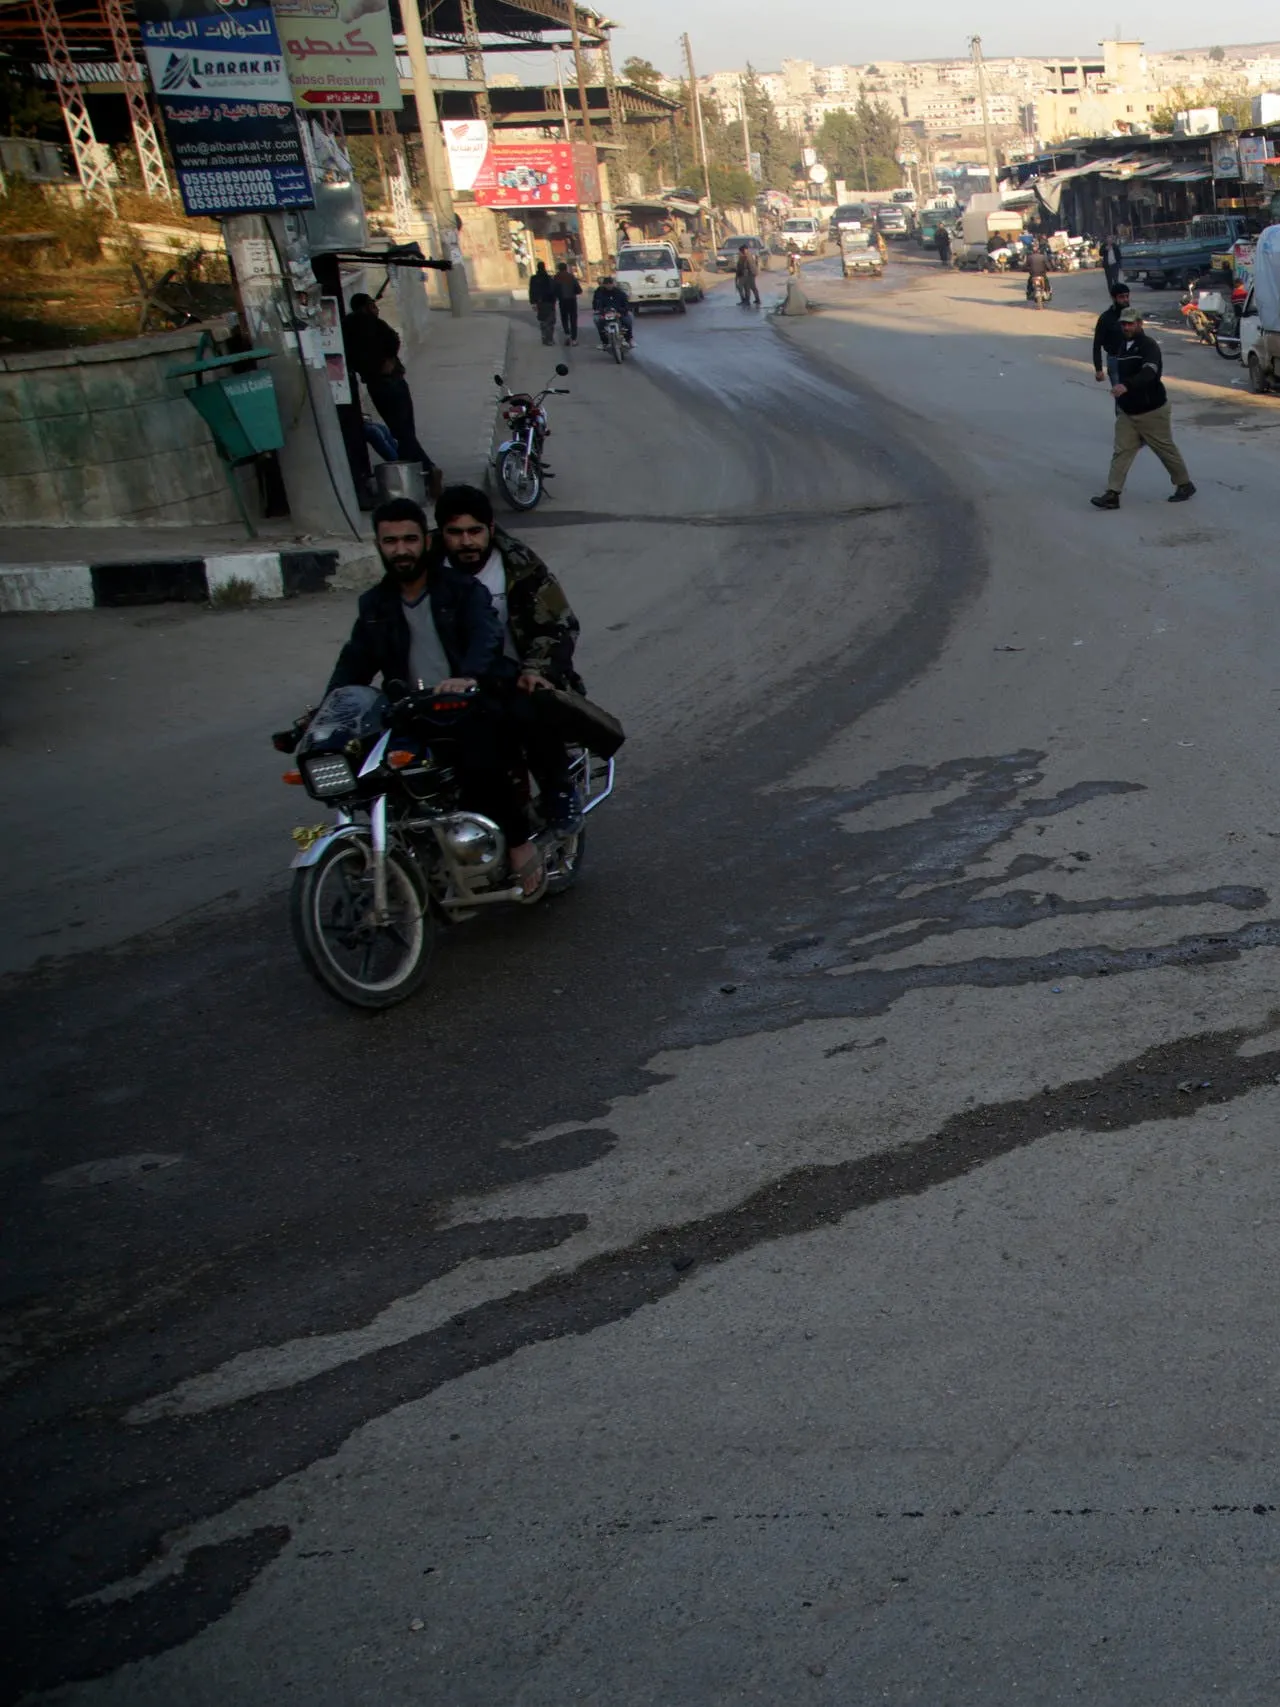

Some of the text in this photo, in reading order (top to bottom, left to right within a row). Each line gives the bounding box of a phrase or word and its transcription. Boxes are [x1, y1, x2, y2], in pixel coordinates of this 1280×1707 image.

[147, 19, 271, 41] للحوالات المالية
[182, 169, 272, 185] 05558890000
[185, 182, 275, 198] 05558950000
[188, 193, 277, 210] 05388632528
